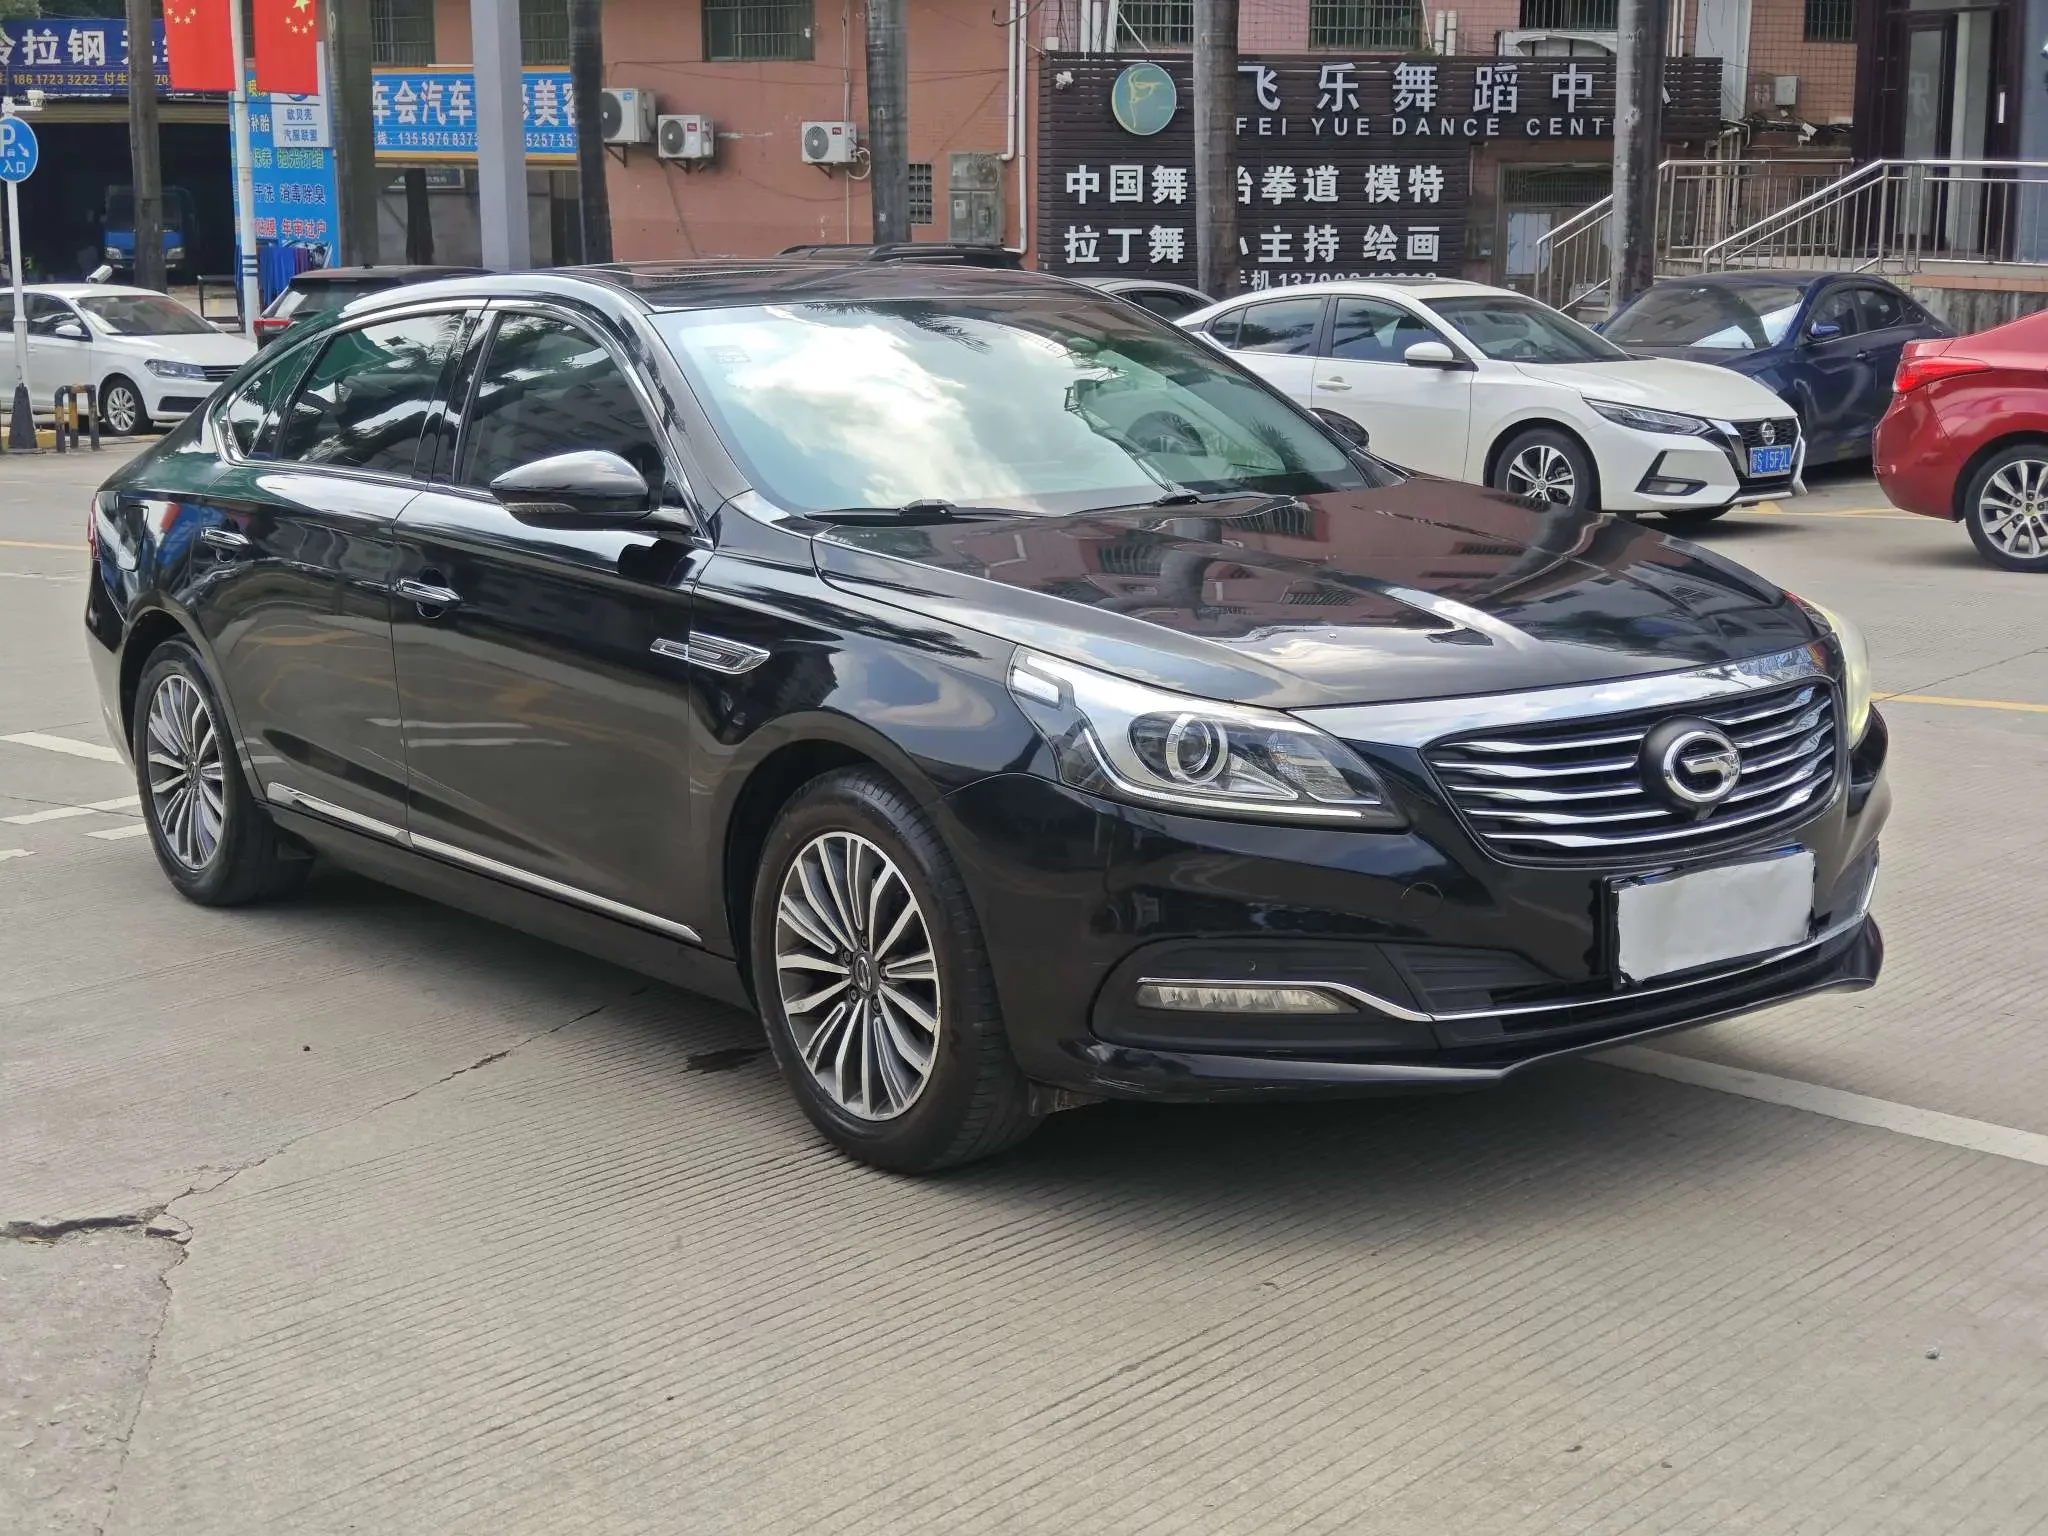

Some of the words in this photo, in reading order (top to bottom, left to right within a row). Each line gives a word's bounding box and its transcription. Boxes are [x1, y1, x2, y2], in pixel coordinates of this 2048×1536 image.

[1237, 62, 1671, 113] 飞乐舞蹈中
[1236, 117, 1287, 136] FEI
[1311, 117, 1370, 136] YUE
[1392, 117, 1500, 136] DANCE
[1526, 117, 1616, 136] CENT
[398, 132, 418, 145] 135
[559, 133, 576, 147] 35
[3, 160, 26, 173] 入口
[280, 182, 327, 206] 消毒除臭
[1066, 164, 1188, 205] 中国舞
[1365, 164, 1444, 204] 模特
[1064, 225, 1185, 264] 拉丁舞
[1239, 224, 1340, 263] 主持
[1363, 224, 1440, 263] 绘画
